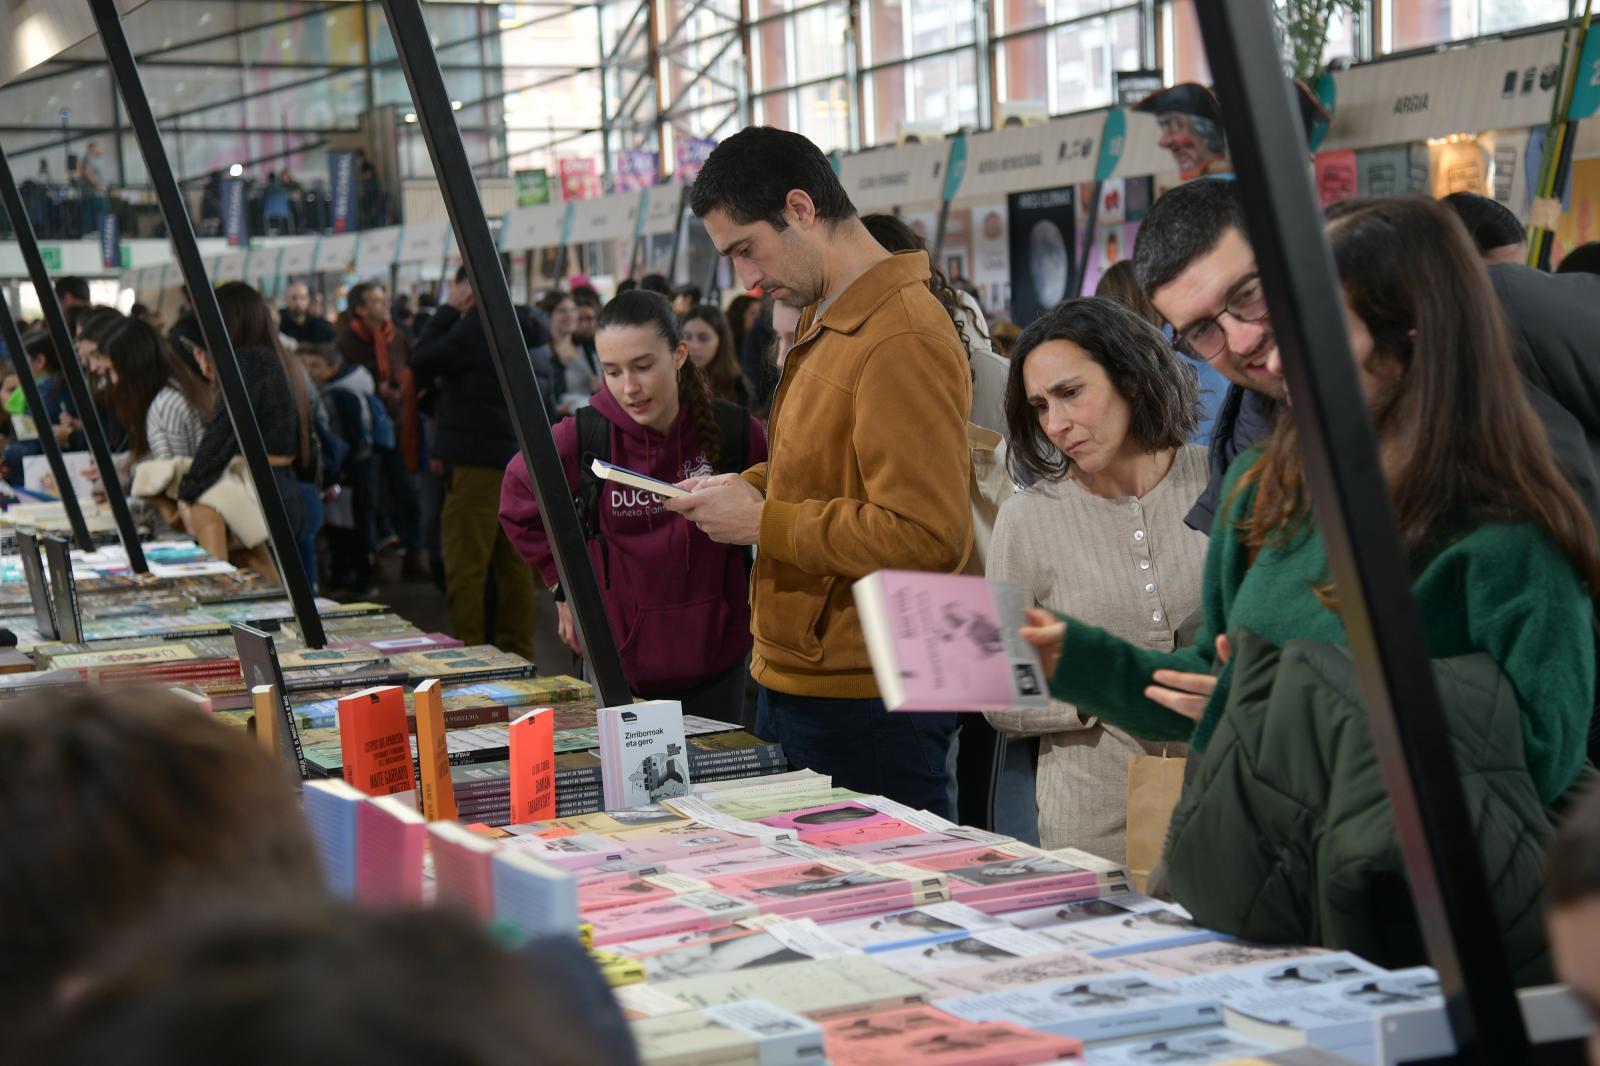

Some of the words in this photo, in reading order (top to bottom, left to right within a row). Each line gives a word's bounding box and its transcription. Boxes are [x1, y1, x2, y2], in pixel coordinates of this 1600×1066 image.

[1392, 94, 1429, 116] ARGIA
[625, 728, 664, 739] Zirriborroak
[638, 738, 653, 747] gero
